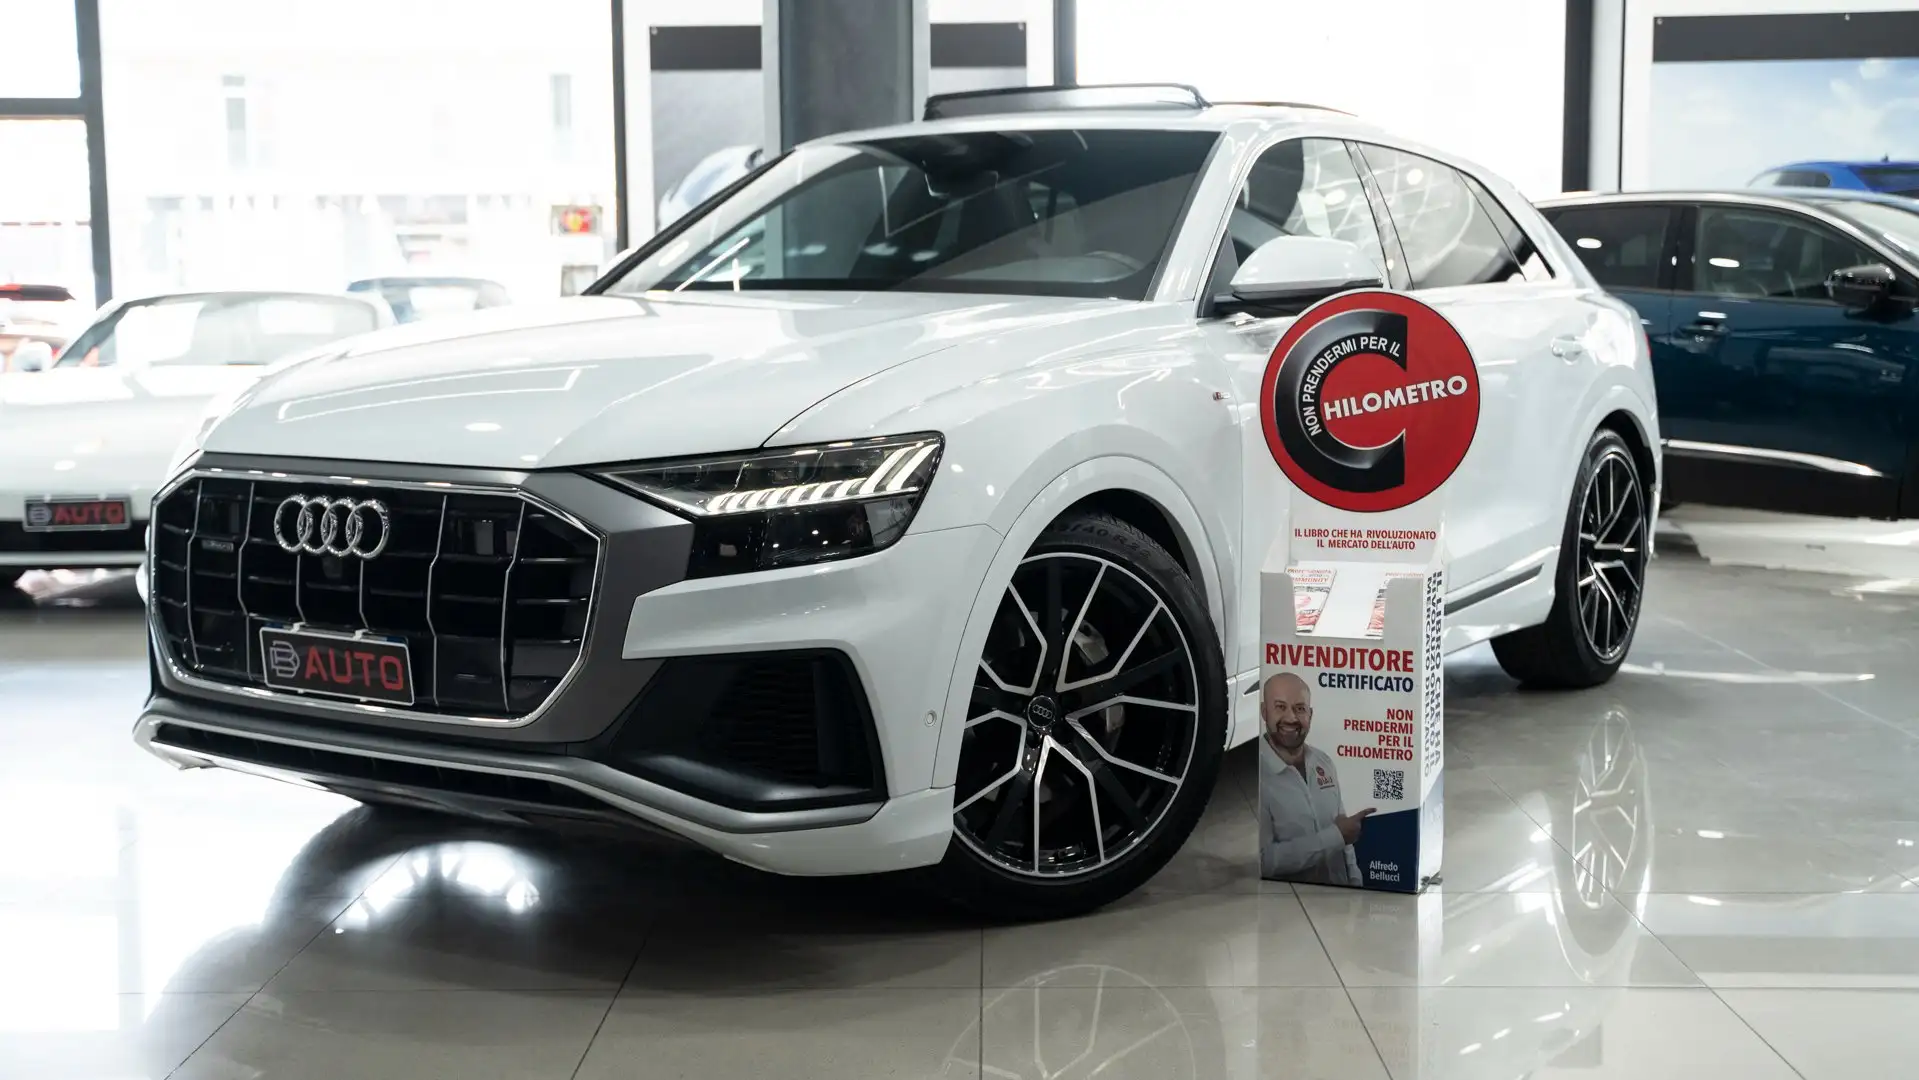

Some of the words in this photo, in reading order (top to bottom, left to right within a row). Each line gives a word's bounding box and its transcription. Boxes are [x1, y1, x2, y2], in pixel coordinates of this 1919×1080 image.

[1360, 336, 1388, 350] PER
[1389, 341, 1401, 357] IL
[1302, 337, 1357, 402] PRENDERMI
[1302, 406, 1322, 436] NON
[55, 503, 123, 523] AUTO
[1294, 528, 1303, 538] IL
[1304, 529, 1329, 538] LIBRO
[1331, 529, 1349, 538] CHE
[1350, 530, 1363, 538] HA
[1367, 530, 1436, 540] RIVOLUZIONATO
[1316, 540, 1325, 548] IL
[1328, 540, 1369, 549] MERCATO
[1371, 541, 1416, 550] DELL'AUTO
[1266, 643, 1414, 673] RIVENDITORE
[305, 646, 404, 690] AUTO
[1318, 672, 1414, 692] CERTIFICATO
[1386, 709, 1413, 721] NON
[1344, 719, 1413, 735] PRENDERMI
[1378, 735, 1401, 746] PER
[1403, 736, 1414, 748] IL
[1337, 745, 1413, 761] CHILOMETRO
[1369, 861, 1399, 871] Alfredo
[1369, 871, 1400, 882] Bellucci
